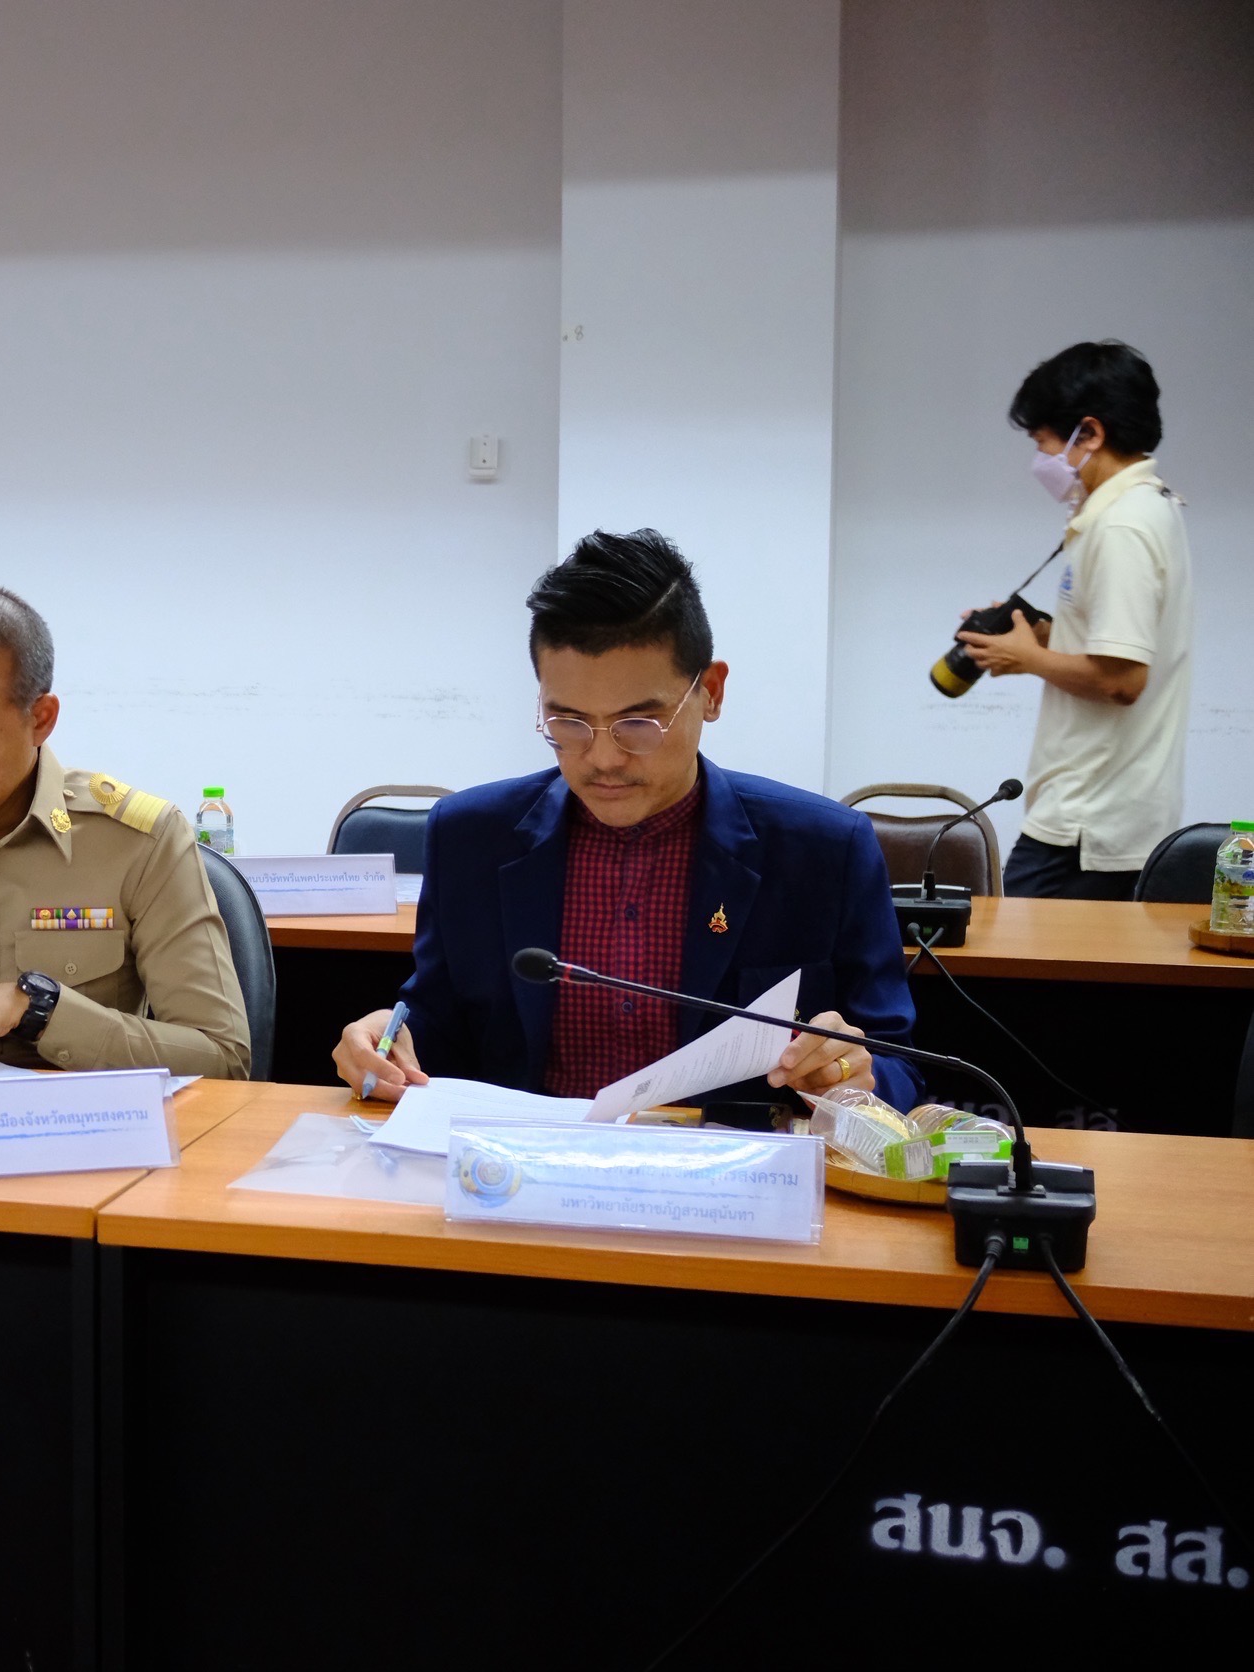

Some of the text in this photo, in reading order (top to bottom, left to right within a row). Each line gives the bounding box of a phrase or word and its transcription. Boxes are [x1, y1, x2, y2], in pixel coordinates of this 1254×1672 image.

[560, 1195, 755, 1223] มหาวิทยาลัยราชภัฏสวนสุนันทา
[871, 1493, 1249, 1589] สนจ. สส.
